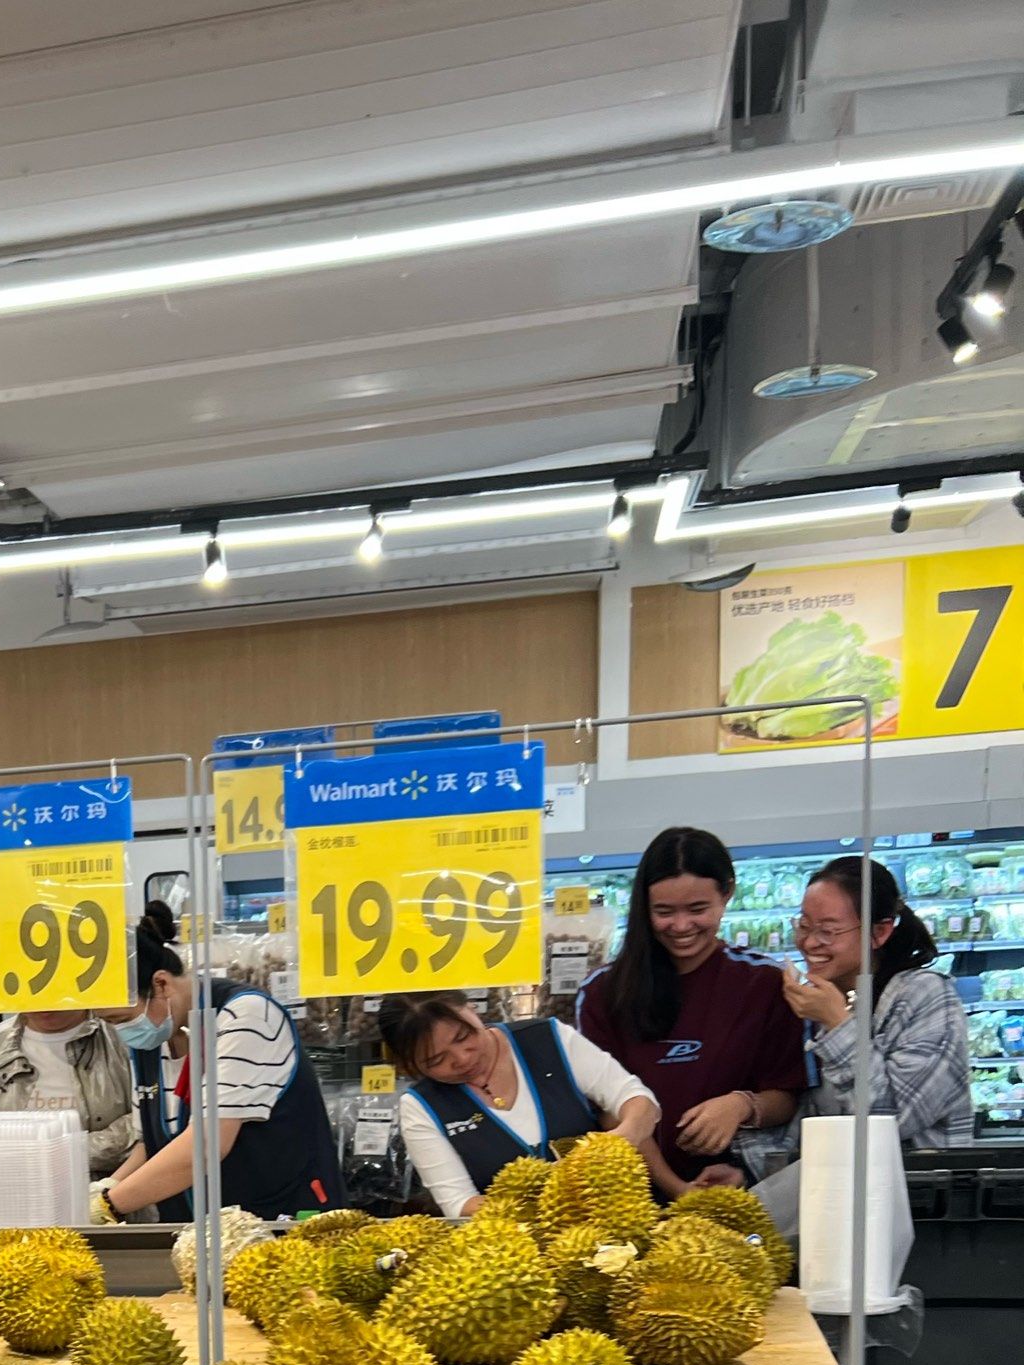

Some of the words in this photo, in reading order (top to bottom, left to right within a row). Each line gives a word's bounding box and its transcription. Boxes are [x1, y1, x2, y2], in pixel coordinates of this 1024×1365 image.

[935, 584, 1014, 709] 7
[33, 802, 108, 824] 沃尔玛
[309, 777, 397, 803] Walmart
[436, 767, 519, 792] 沃尔玛
[311, 871, 523, 978] 19.99
